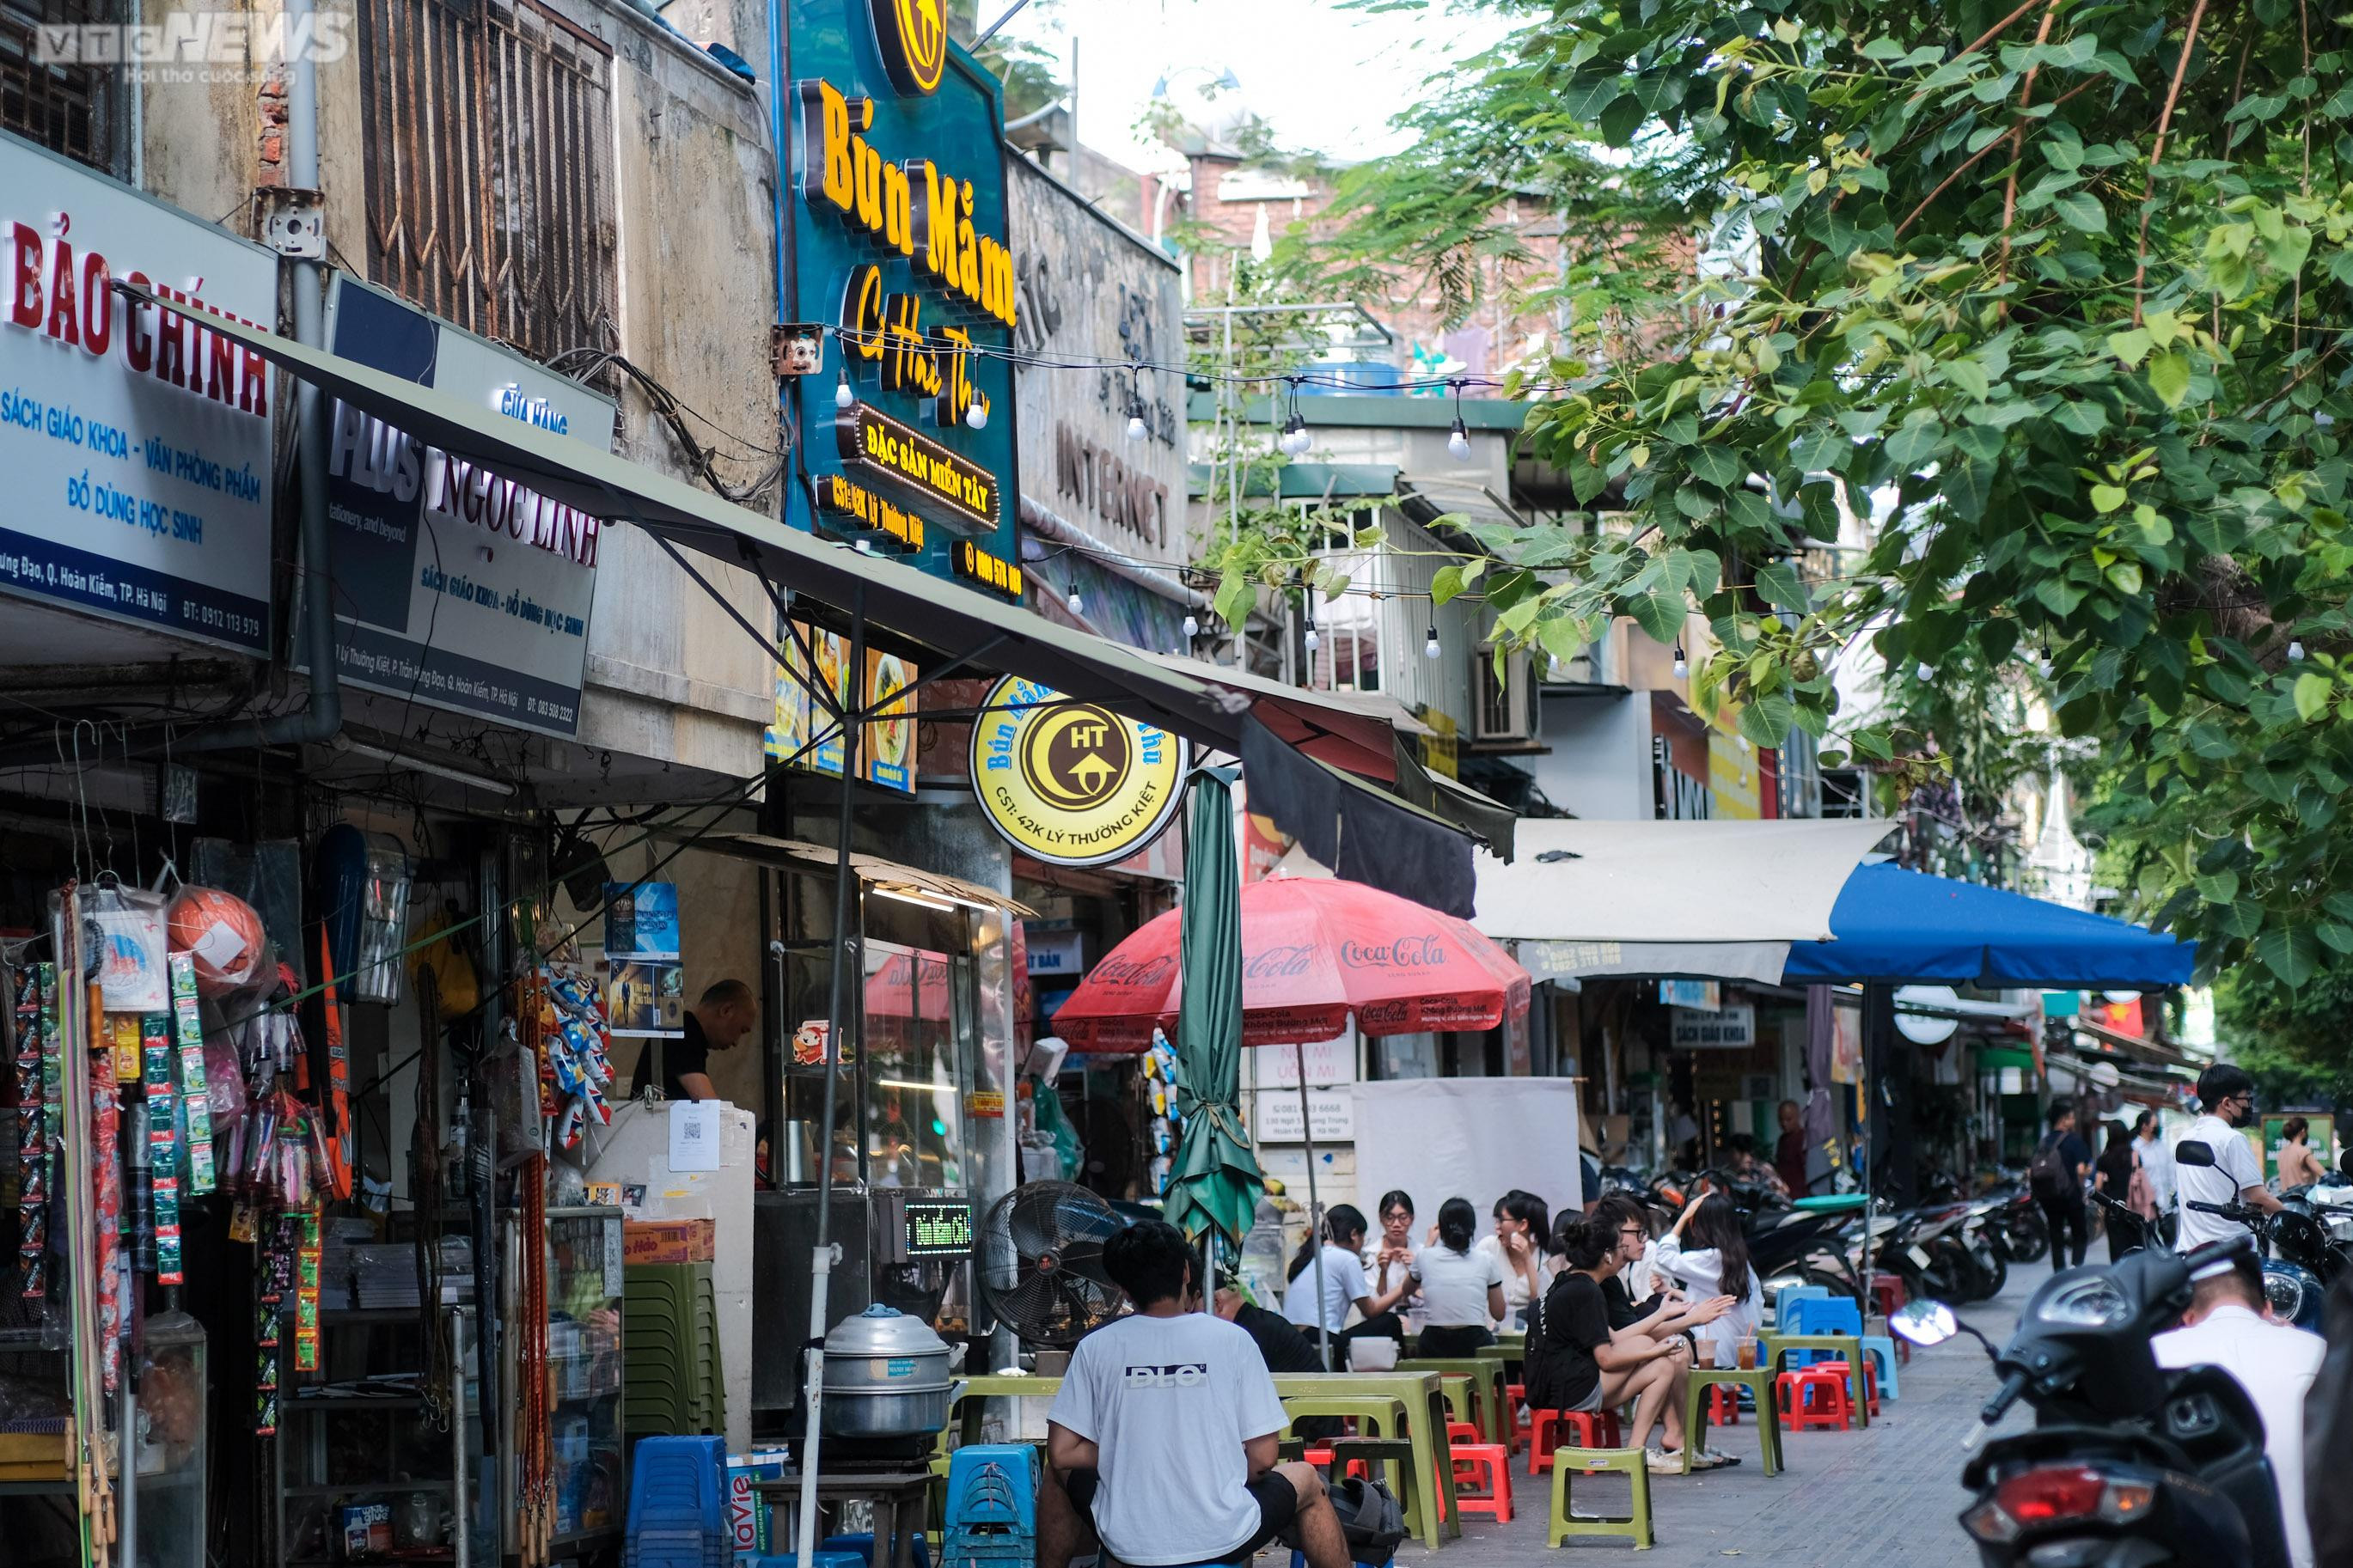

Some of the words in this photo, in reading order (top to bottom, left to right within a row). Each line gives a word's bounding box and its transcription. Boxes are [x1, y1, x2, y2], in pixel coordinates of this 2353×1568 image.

[820, 77, 914, 256] Bún
[924, 158, 1017, 328] Mắm
[12, 211, 111, 355] BẢO
[125, 272, 267, 418] CHÍNH
[890, 291, 943, 396] Hai
[1, 387, 42, 431] SÁCH
[46, 405, 83, 445] GIÁO
[88, 421, 129, 461] KHOA
[144, 436, 172, 474] VĂN
[175, 449, 221, 491] PHÒNG
[330, 397, 420, 503] PLUS
[866, 423, 897, 465] ĐẶC
[899, 436, 928, 480] SẢN
[929, 457, 962, 500] MIỀN
[963, 475, 988, 513] TÂY
[68, 468, 89, 511] ĐỒ
[95, 481, 135, 525] DÙNG
[140, 499, 168, 539] HỌC
[173, 509, 203, 545] SINH
[21, 556, 44, 583] Đạo,
[46, 563, 58, 586] Q.
[60, 566, 86, 591] Hoàn
[119, 583, 134, 603] TP.
[137, 588, 149, 607] Hà
[150, 592, 167, 616] Nội
[183, 601, 199, 619] ĐT:
[202, 605, 223, 628] 0912
[227, 611, 240, 631] 113
[243, 614, 259, 637] 979
[449, 573, 474, 601] GIÁO
[475, 585, 499, 611] KHOA
[520, 599, 542, 625] DÙNG
[987, 723, 1017, 771] Bún
[1071, 725, 1109, 748] HT
[996, 785, 1018, 816] CS1:
[1018, 815, 1045, 839] 42K
[1046, 828, 1066, 845] LÝ
[1068, 813, 1134, 845] THƯỜNG
[1129, 780, 1159, 818] KIỆT
[1340, 933, 1447, 969] Coca-Cola
[364, 1512, 388, 1527] glue
